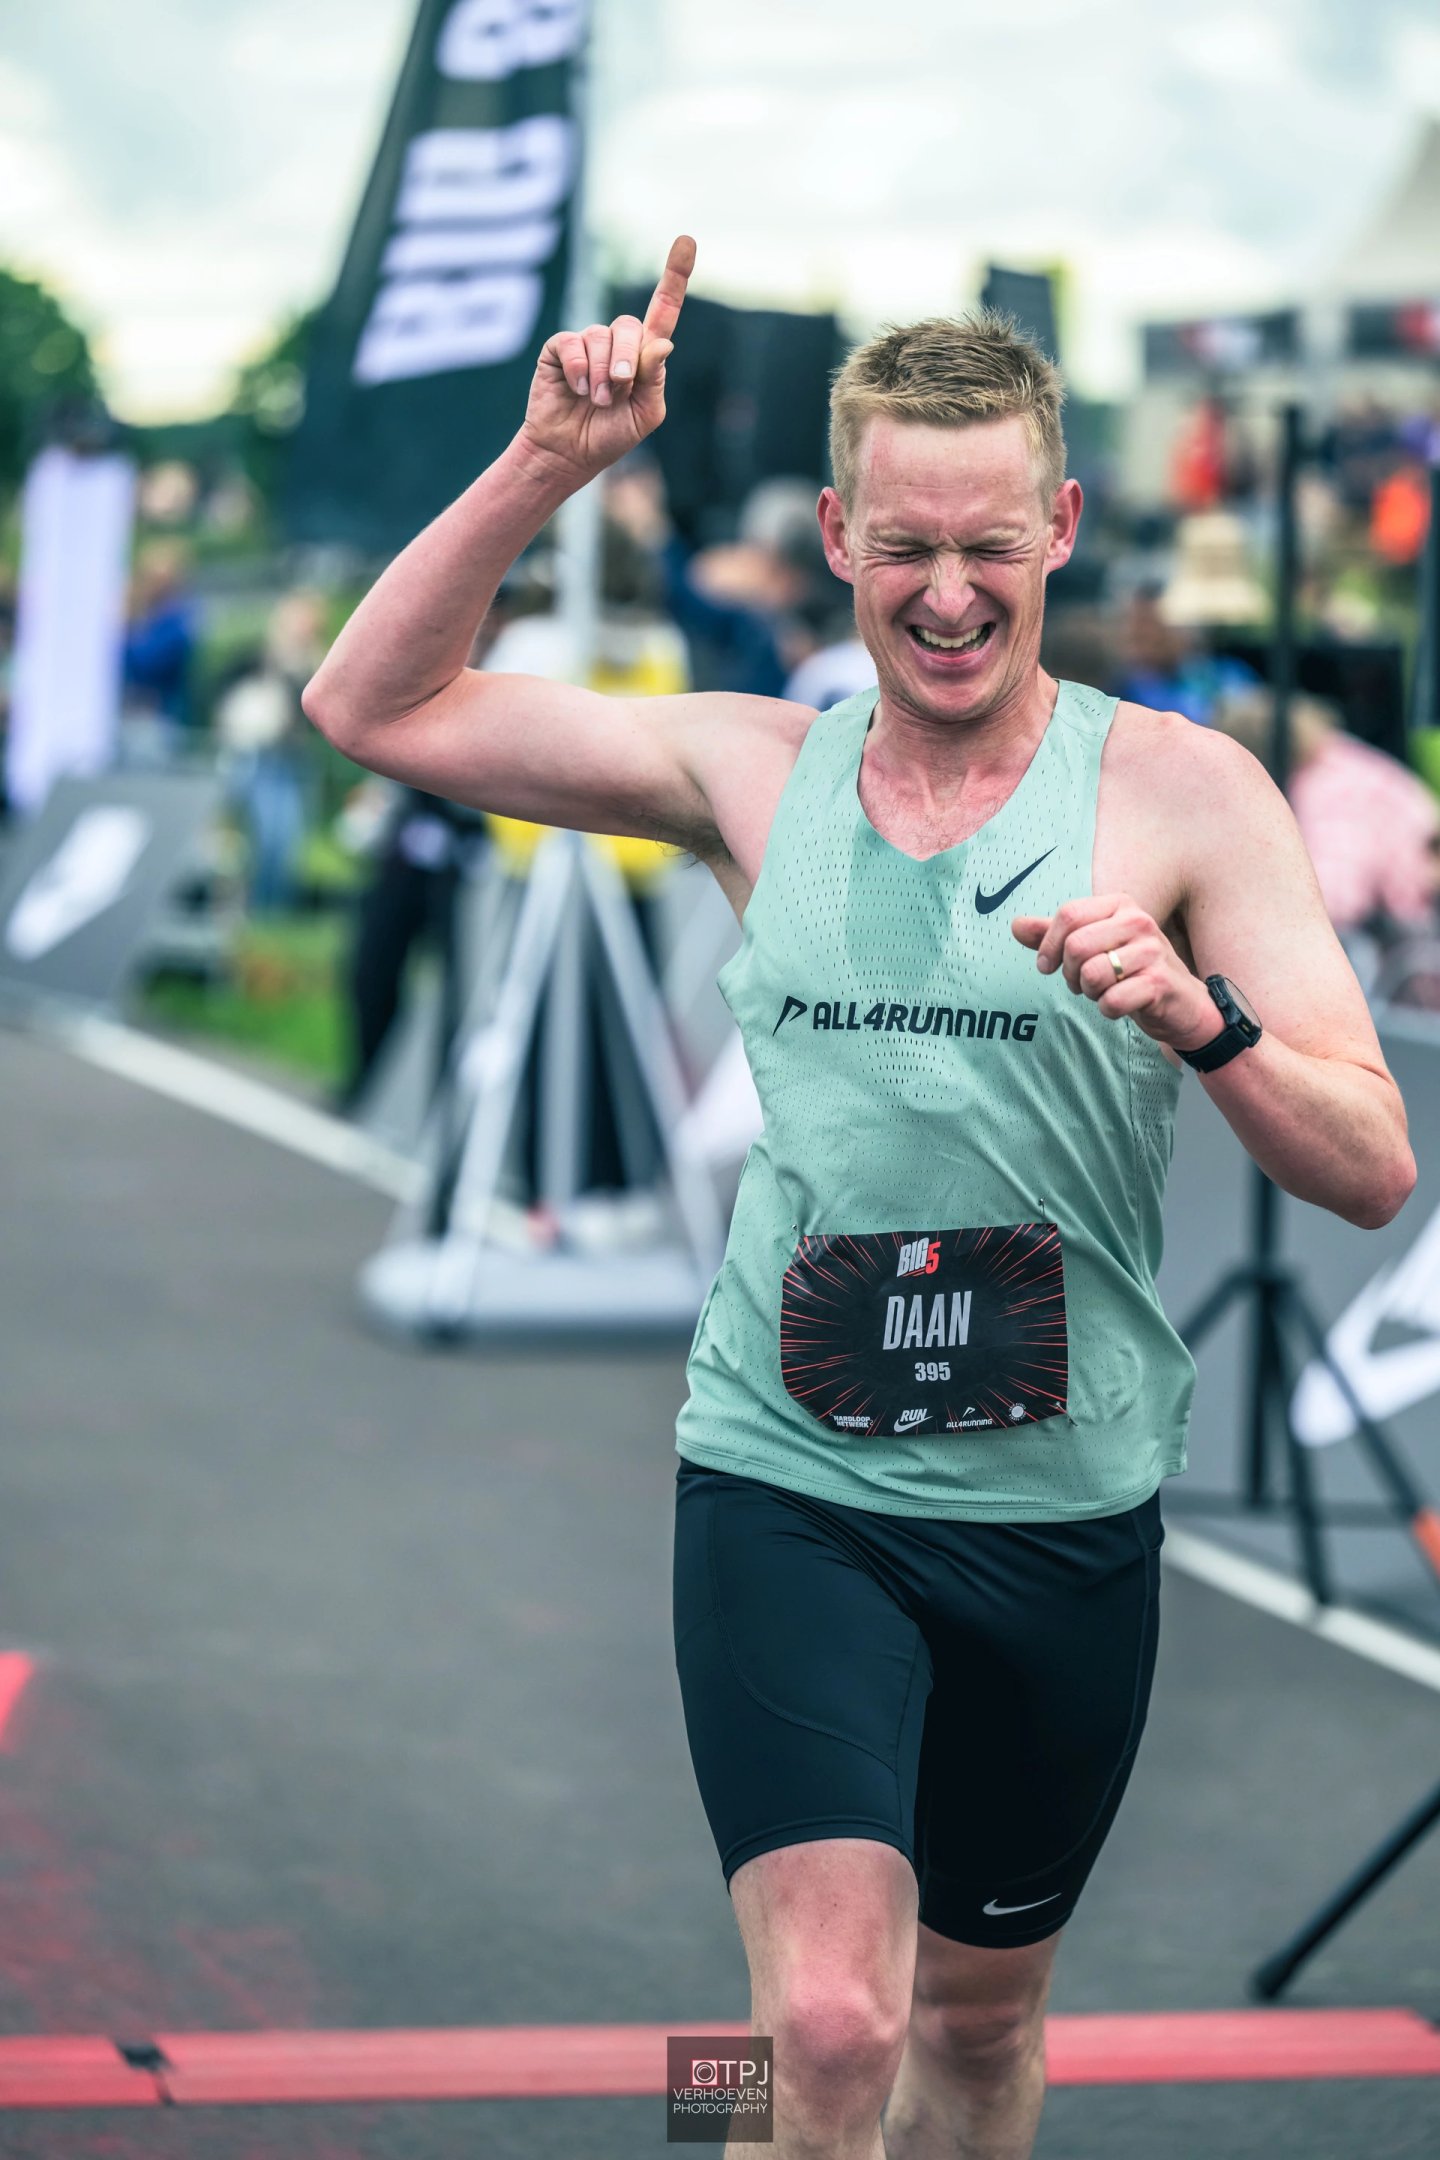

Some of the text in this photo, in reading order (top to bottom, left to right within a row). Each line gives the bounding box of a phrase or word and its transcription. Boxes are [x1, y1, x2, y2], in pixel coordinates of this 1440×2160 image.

[812, 1001, 1039, 1042] ALL4RUNNING
[896, 1236, 942, 1277] BIG5
[882, 1290, 973, 1351] DAAN
[914, 1361, 951, 1382] 395
[833, 1415, 871, 1423] HARDLOOP
[900, 1408, 928, 1423] RUN
[946, 1418, 993, 1429] ALL4RUNNING
